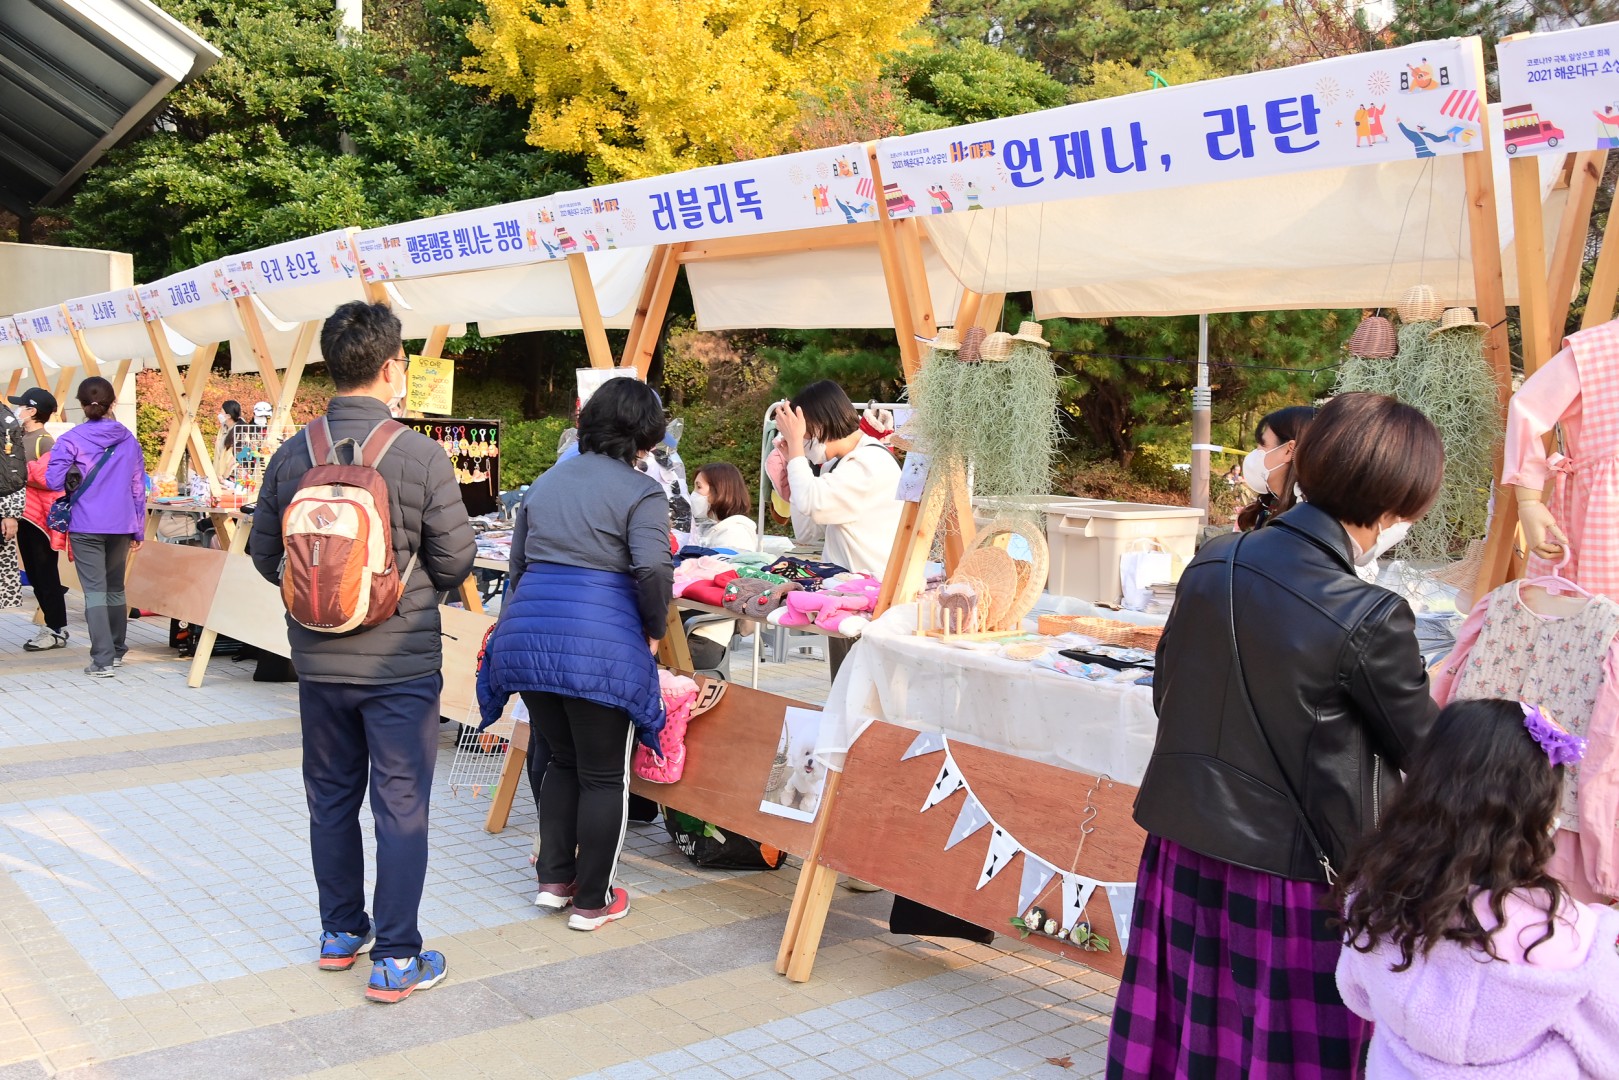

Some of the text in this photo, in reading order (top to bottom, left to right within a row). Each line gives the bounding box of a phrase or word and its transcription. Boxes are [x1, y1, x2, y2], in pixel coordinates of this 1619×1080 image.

[1527, 69, 1552, 82] 2021
[1554, 62, 1599, 79] 해운대구
[1002, 94, 1320, 188] 언제나, 라탄
[925, 153, 947, 165] 소상공인
[649, 178, 763, 231] 러블리독
[453, 225, 493, 258] 빛나는
[493, 219, 523, 252] 공방
[261, 251, 320, 283] 우리 손으로
